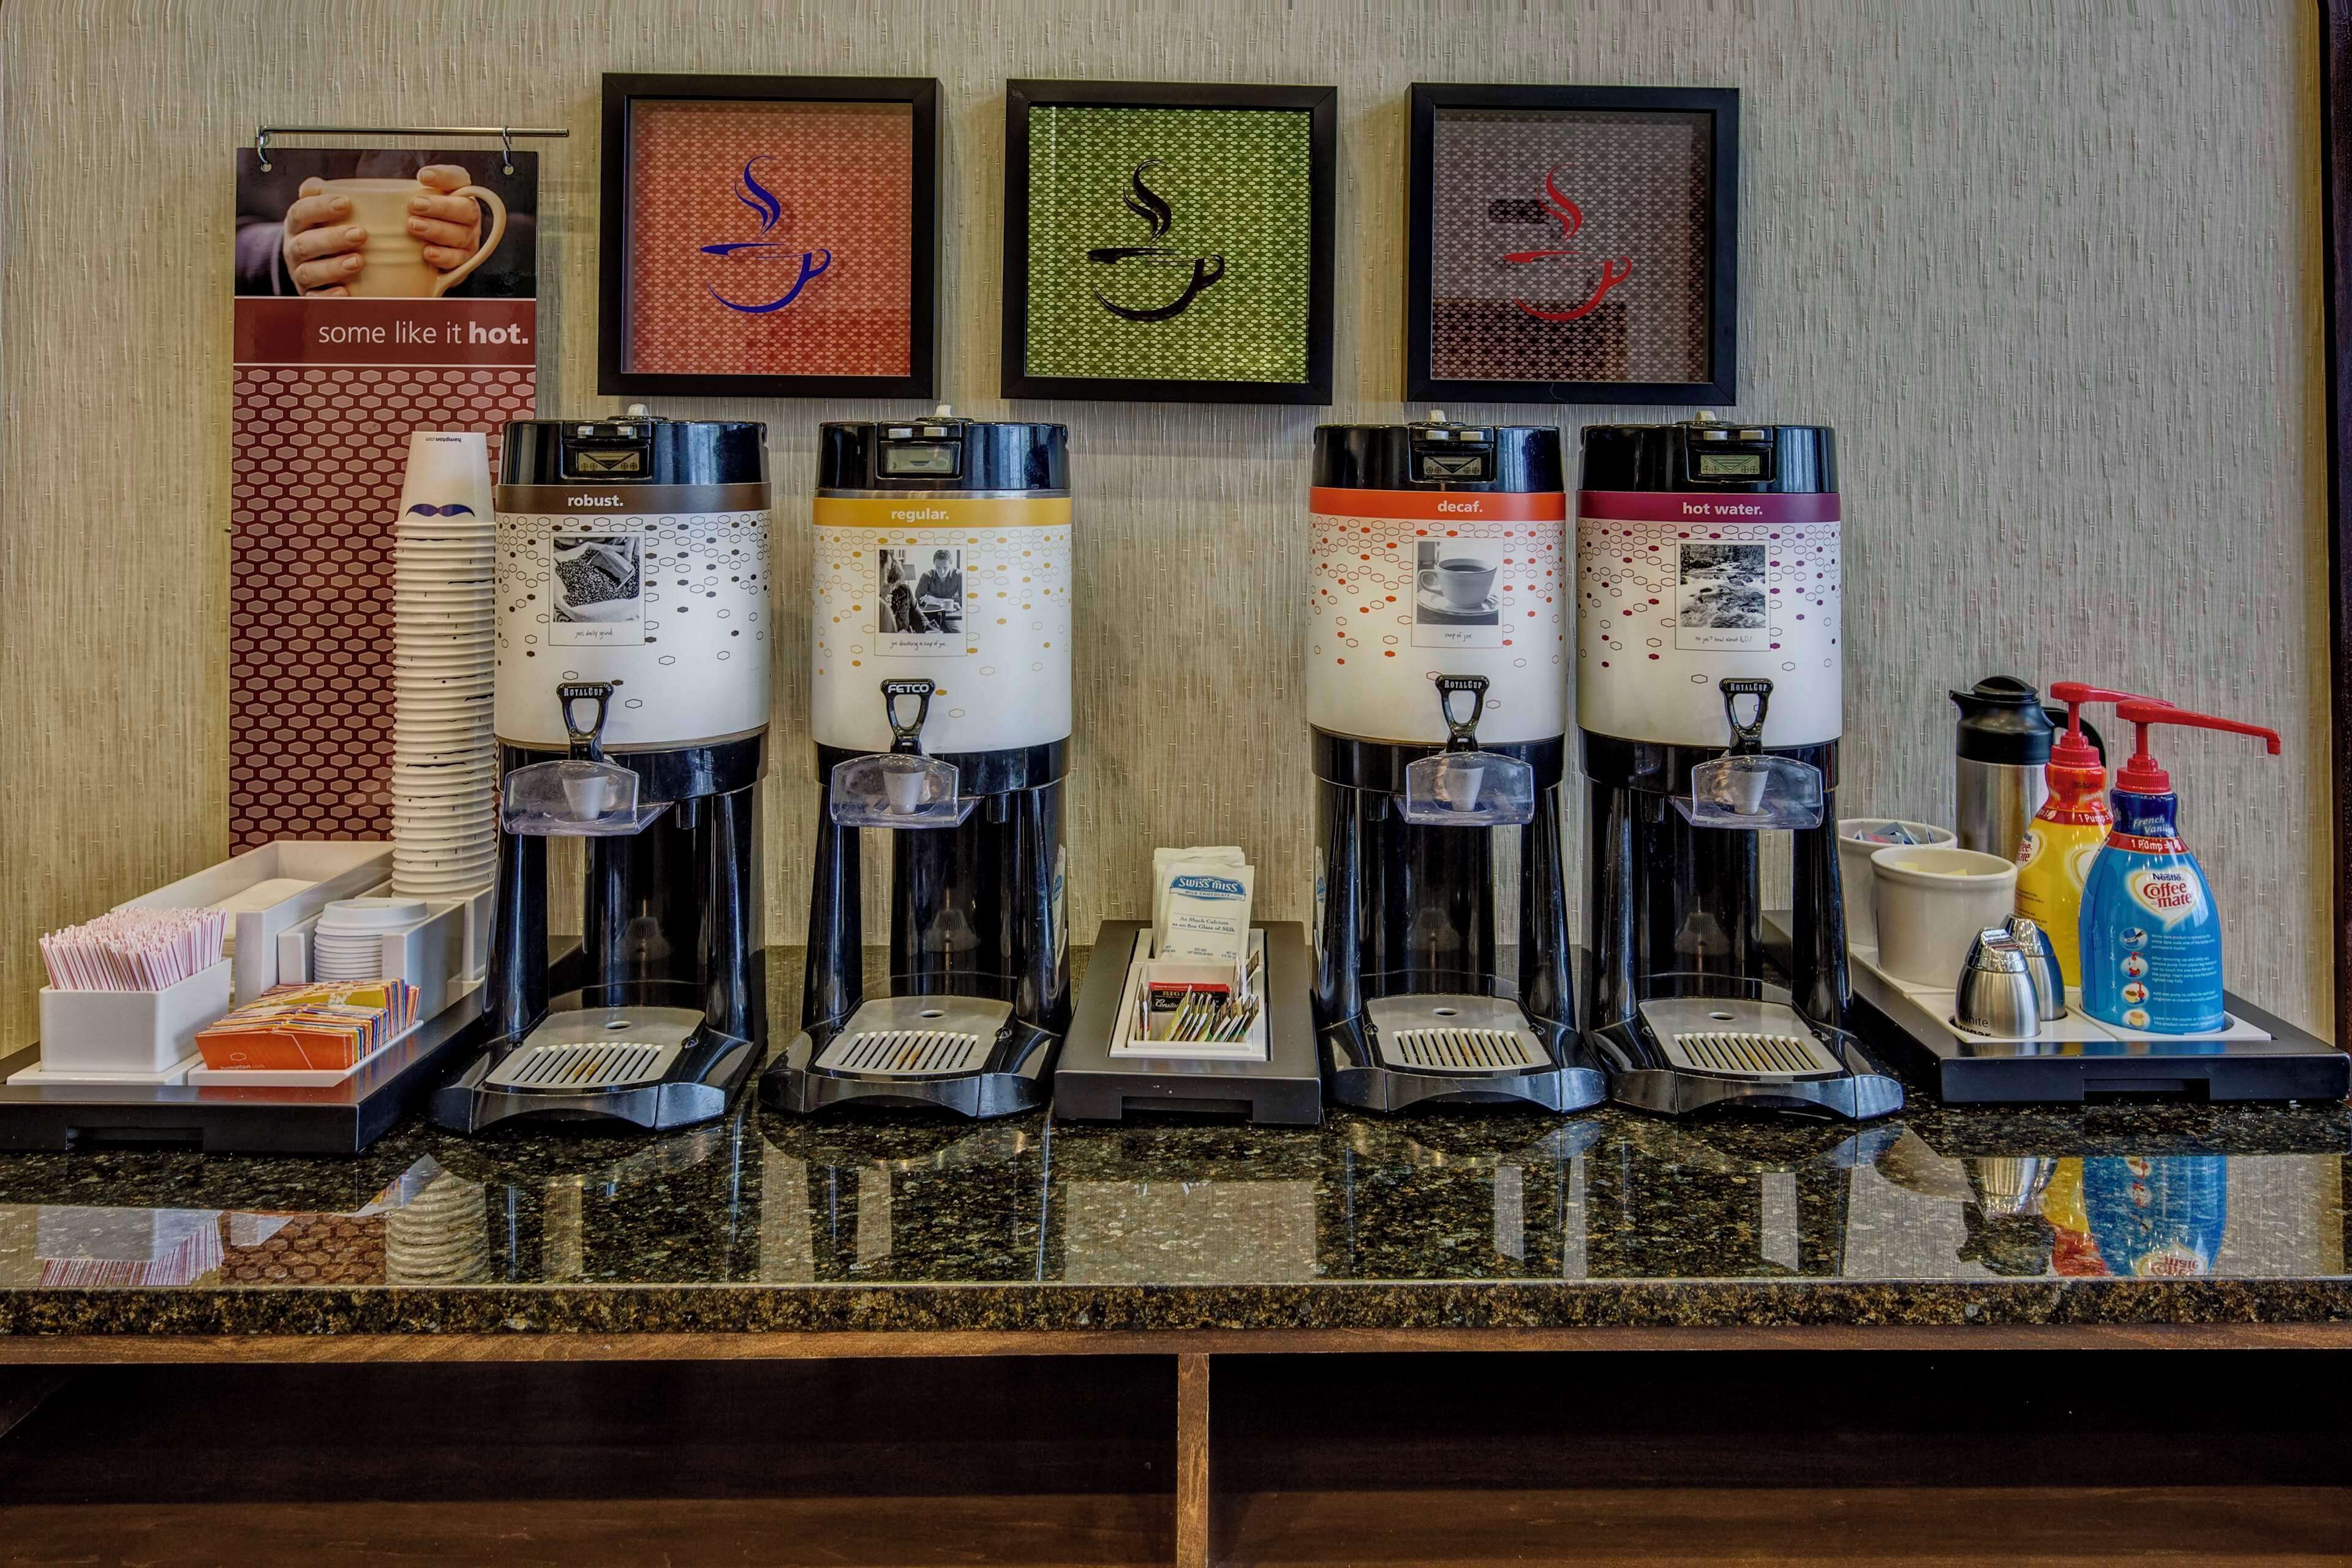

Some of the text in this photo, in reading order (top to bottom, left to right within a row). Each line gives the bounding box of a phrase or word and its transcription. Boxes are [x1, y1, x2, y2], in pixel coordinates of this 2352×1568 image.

[318, 320, 529, 344] some like it hot.
[568, 494, 624, 507] robust.
[1437, 500, 1483, 513] decaf.
[891, 507, 949, 522] regular.
[1683, 502, 1763, 515] hot water.
[887, 684, 930, 693] FETCO
[2133, 815, 2165, 827] French
[2132, 839, 2136, 848] 1
[1178, 877, 1238, 892] SWISS MISS
[2143, 882, 2187, 899] Coffee
[2157, 892, 2192, 908] mate
[1960, 1014, 1989, 1028] white
